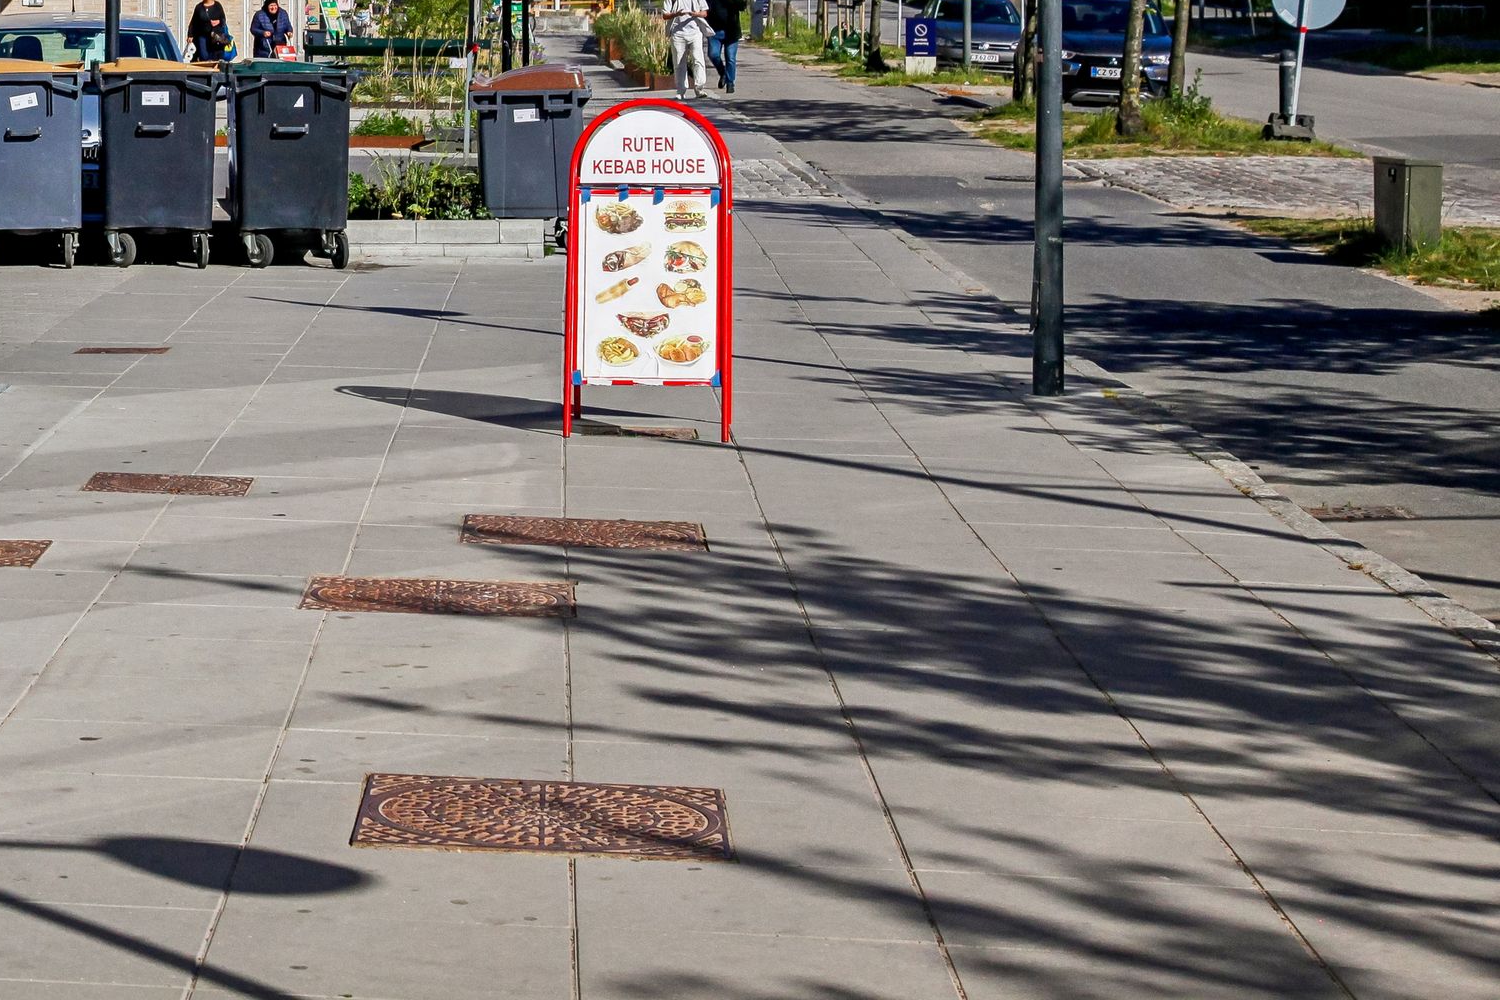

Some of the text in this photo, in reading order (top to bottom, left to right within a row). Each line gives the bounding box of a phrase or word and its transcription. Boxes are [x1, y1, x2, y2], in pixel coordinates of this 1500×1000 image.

[622, 137, 674, 152] RUTEN
[593, 159, 705, 174] KEBAB HOUSE
